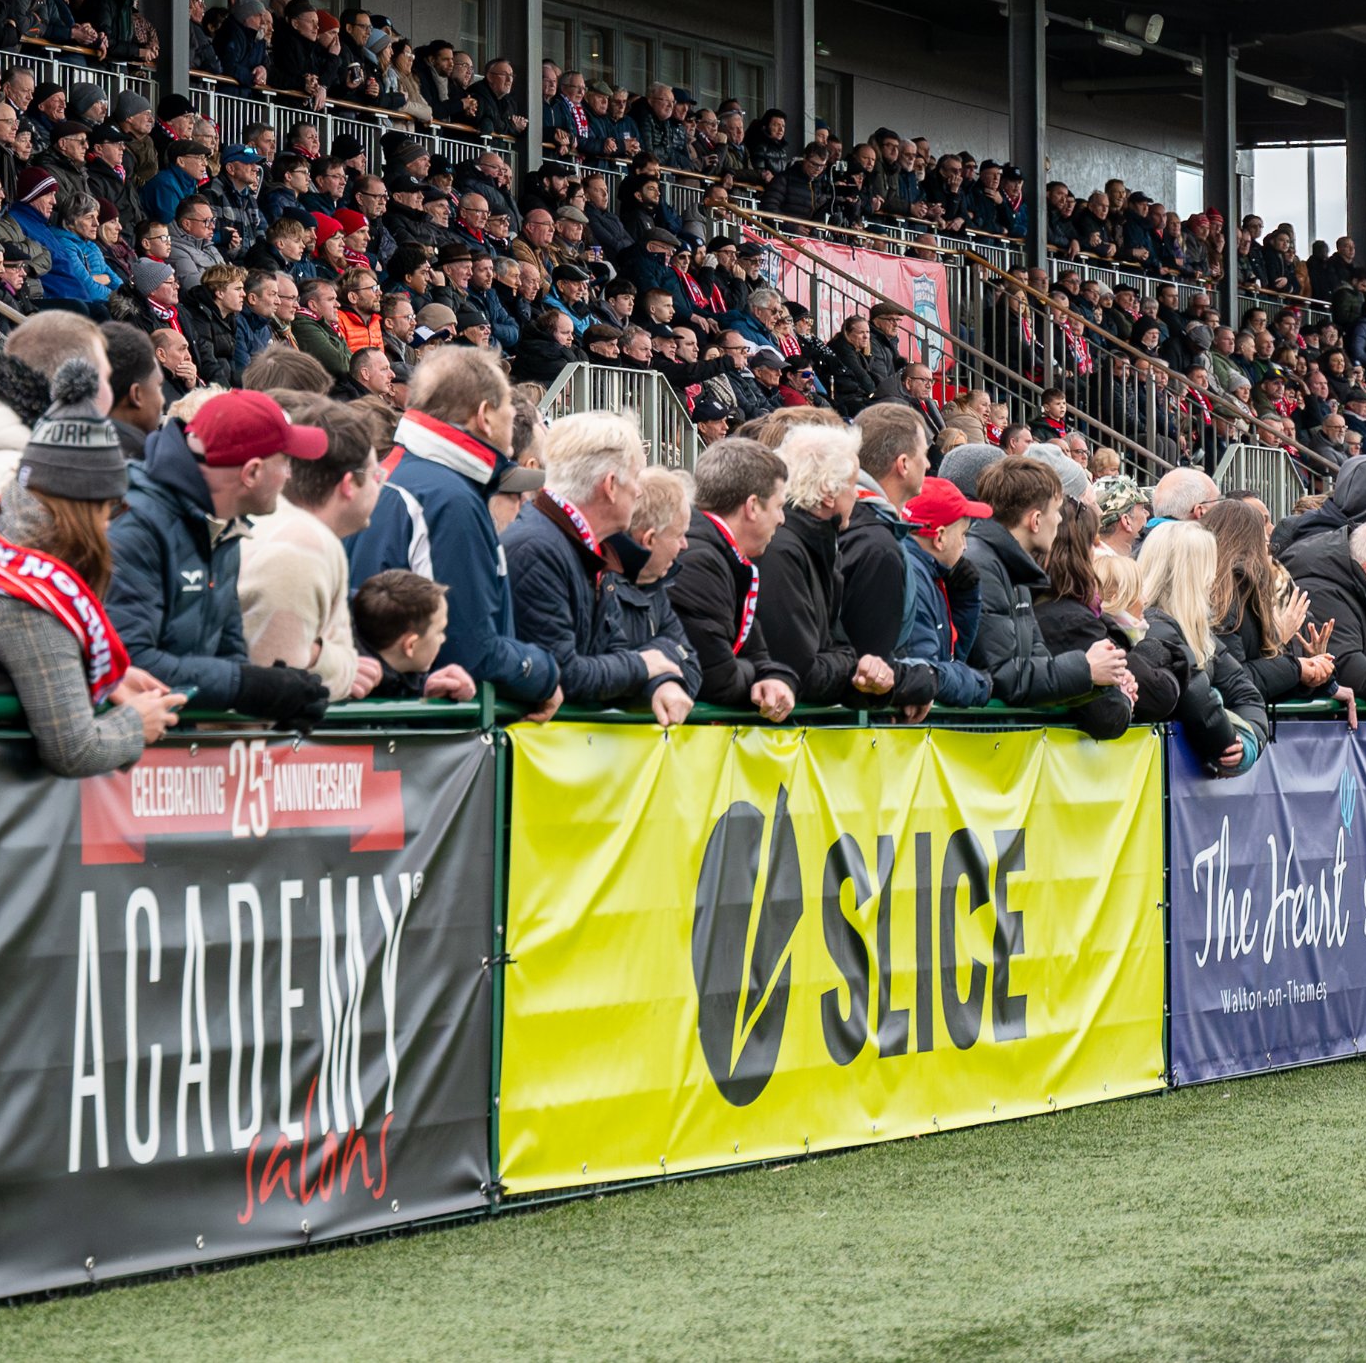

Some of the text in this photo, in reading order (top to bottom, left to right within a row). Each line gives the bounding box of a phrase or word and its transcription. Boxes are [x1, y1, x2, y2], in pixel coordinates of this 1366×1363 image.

[131, 739, 364, 838] CELEBRATING 25th ANNIVERSARY
[821, 827, 1027, 1067] SLICE
[1193, 814, 1351, 969] The Heart
[1220, 980, 1328, 1015] Walton-on-Thames
[237, 1074, 395, 1225] salons
